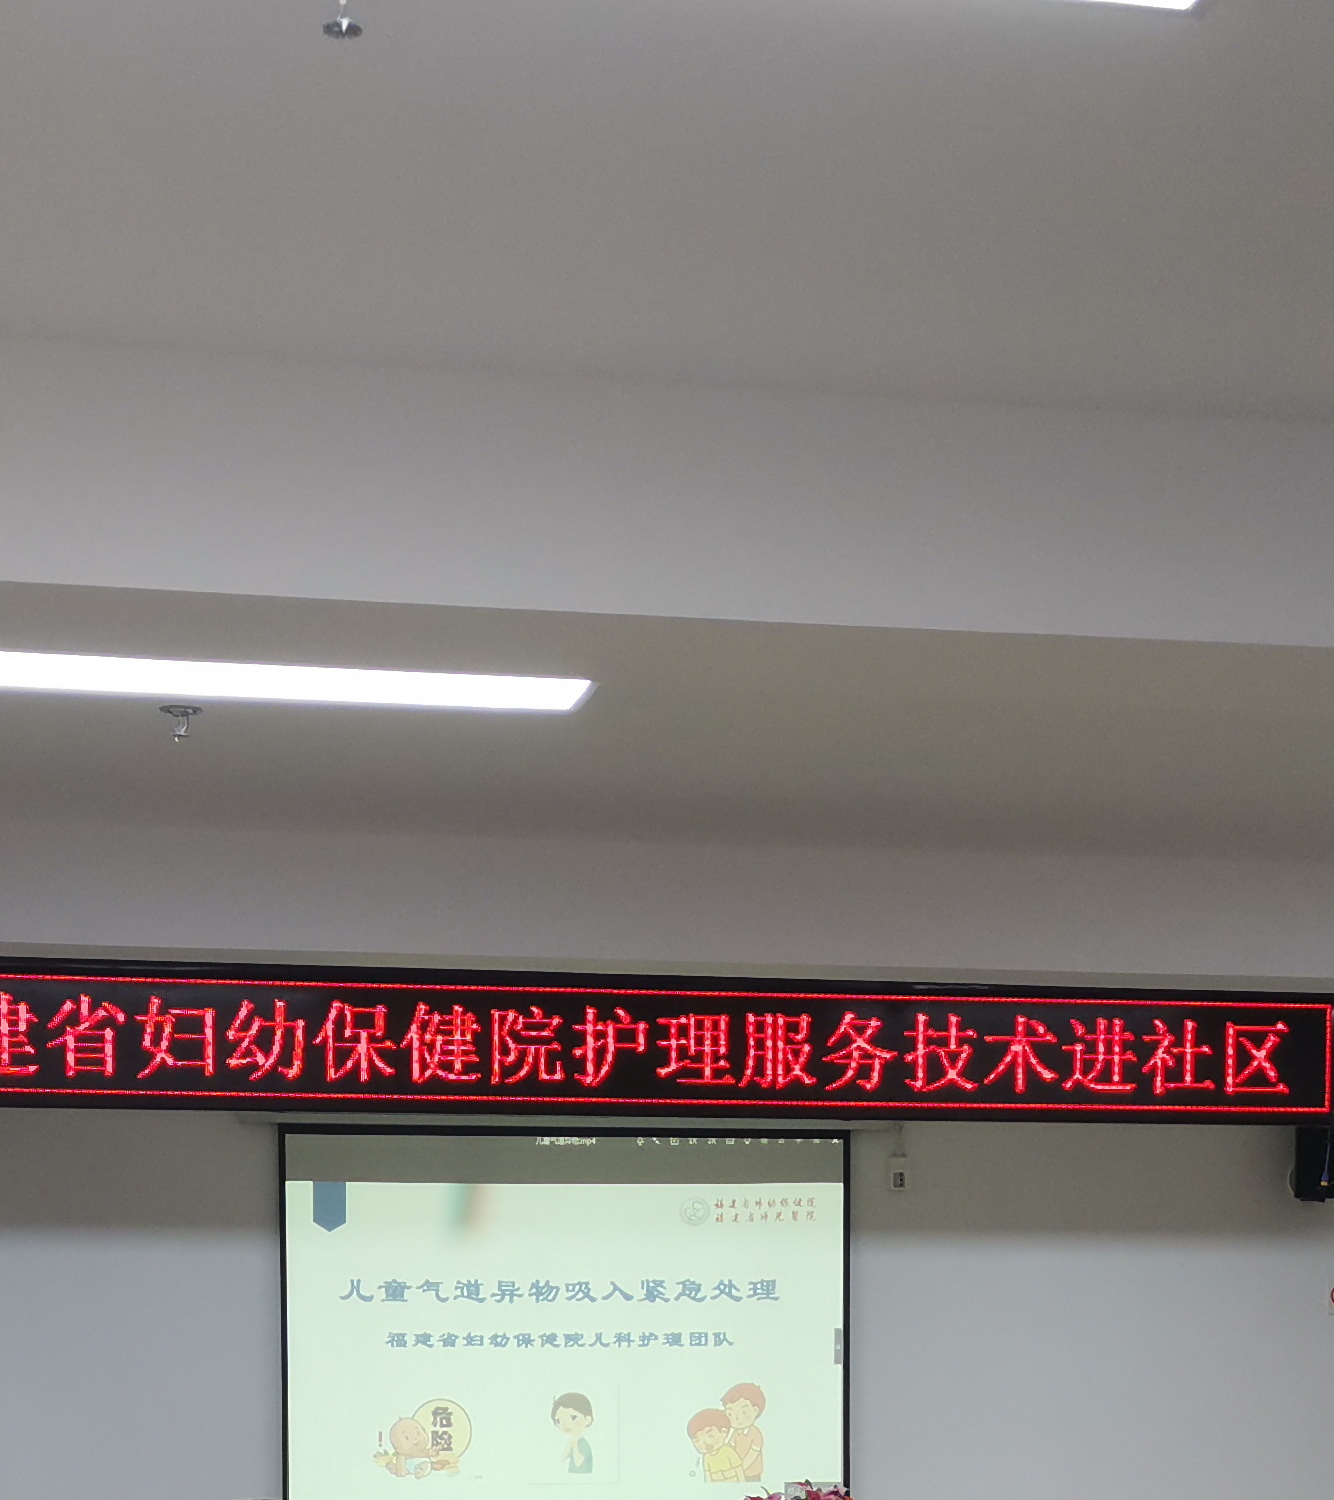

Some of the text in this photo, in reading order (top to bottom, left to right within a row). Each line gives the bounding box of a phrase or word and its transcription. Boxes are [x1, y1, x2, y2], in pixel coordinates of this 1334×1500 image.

[339, 1278, 780, 1304] 儿童气道异物吸入紧急处理
[385, 1331, 734, 1348] 福建省妇幼保健院儿科护理团队
[431, 1406, 453, 1451] 危险
